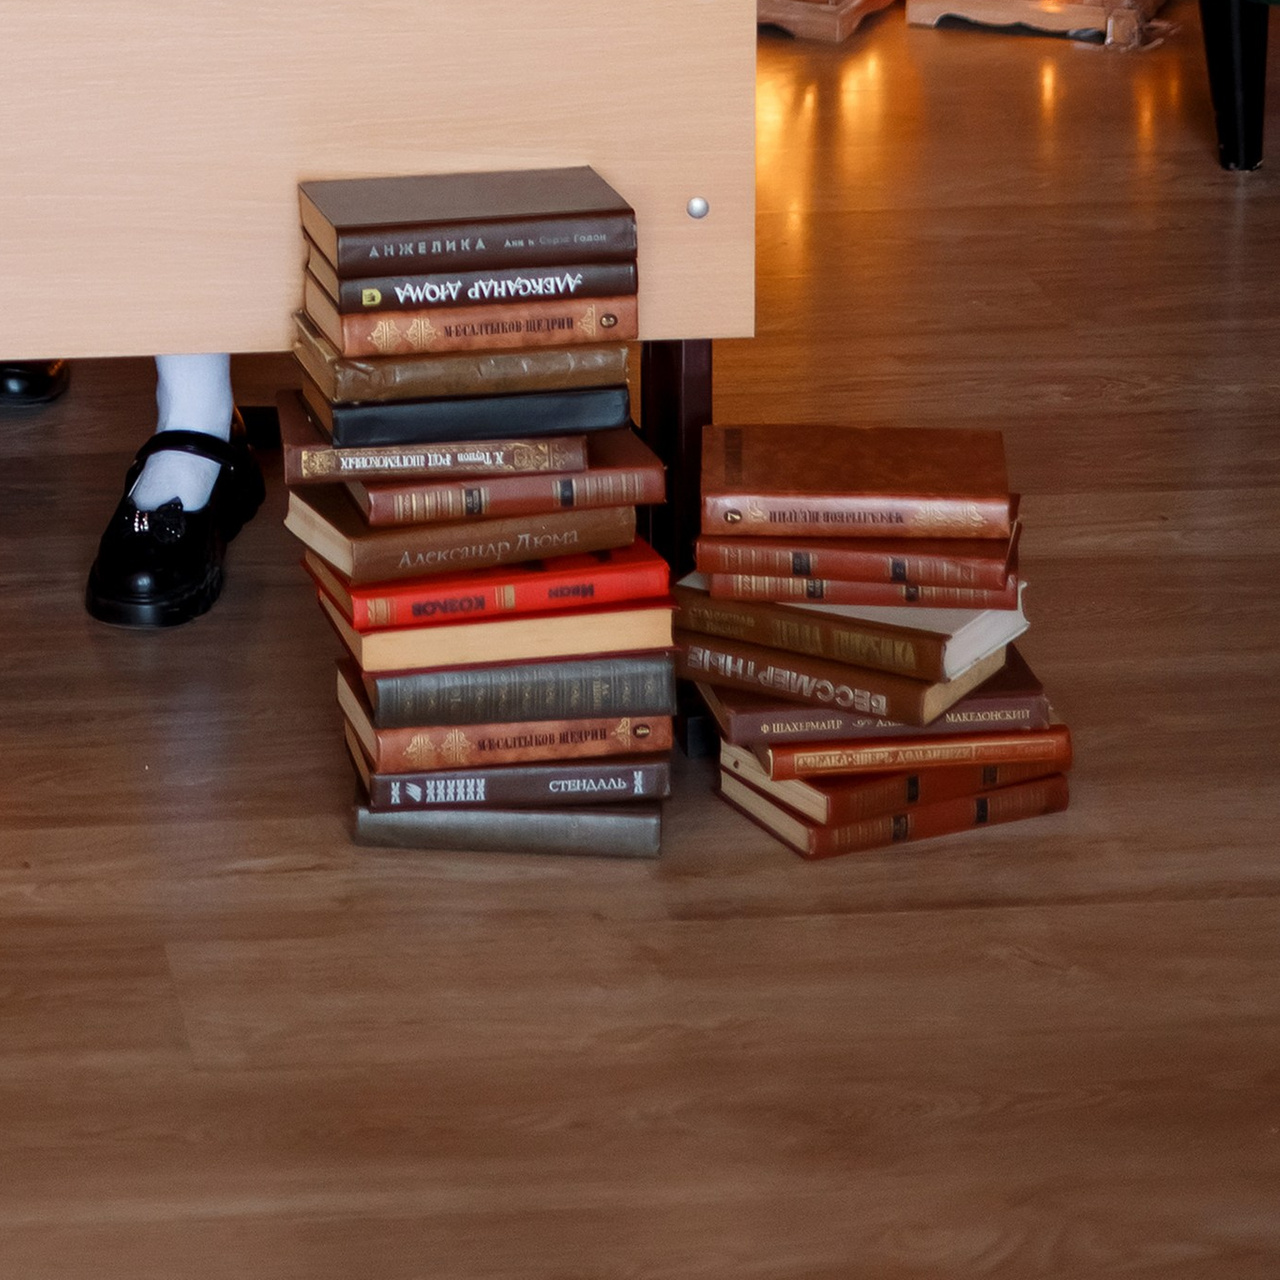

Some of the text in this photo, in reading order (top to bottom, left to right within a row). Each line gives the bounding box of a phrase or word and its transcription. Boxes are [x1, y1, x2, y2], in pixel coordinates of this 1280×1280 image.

[369, 237, 486, 258] АНЖЕЛИКА
[394, 273, 584, 303] АЛЕКСАНДР ДЮМА
[398, 530, 579, 569] Александр Дюма
[411, 583, 595, 618] Иван КОЗЛОВ
[687, 645, 888, 717] БЕССМЕРТНЫЕ
[945, 708, 1031, 724] МАКЕДОНСКИЙ
[548, 777, 628, 794] СТЕНДАЛЬ
